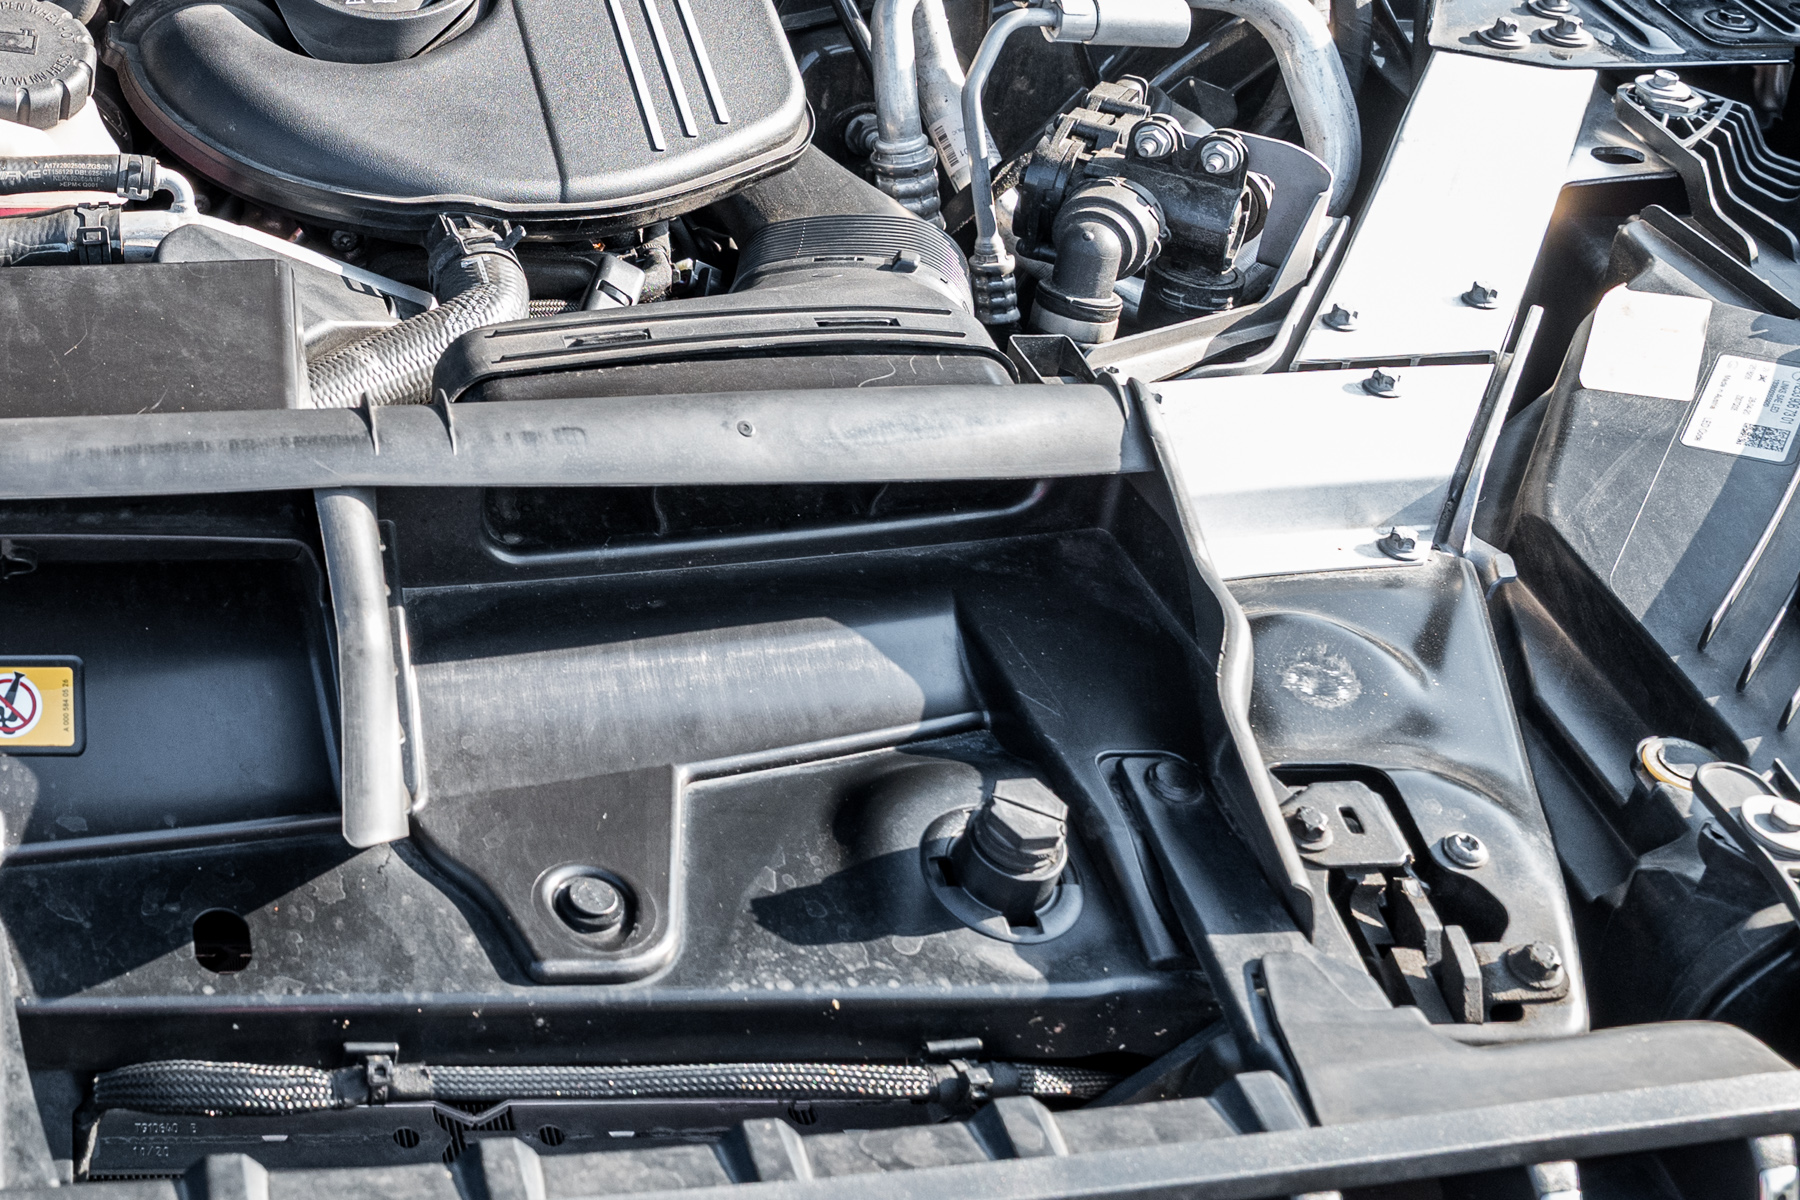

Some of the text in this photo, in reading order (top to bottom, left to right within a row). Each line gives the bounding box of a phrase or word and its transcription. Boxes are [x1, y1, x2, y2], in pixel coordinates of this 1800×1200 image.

[29, 4, 64, 27] WHEN
[1778, 380, 1791, 395] LINKS
[1774, 394, 1786, 404] SAE
[1769, 402, 1781, 414] LED
